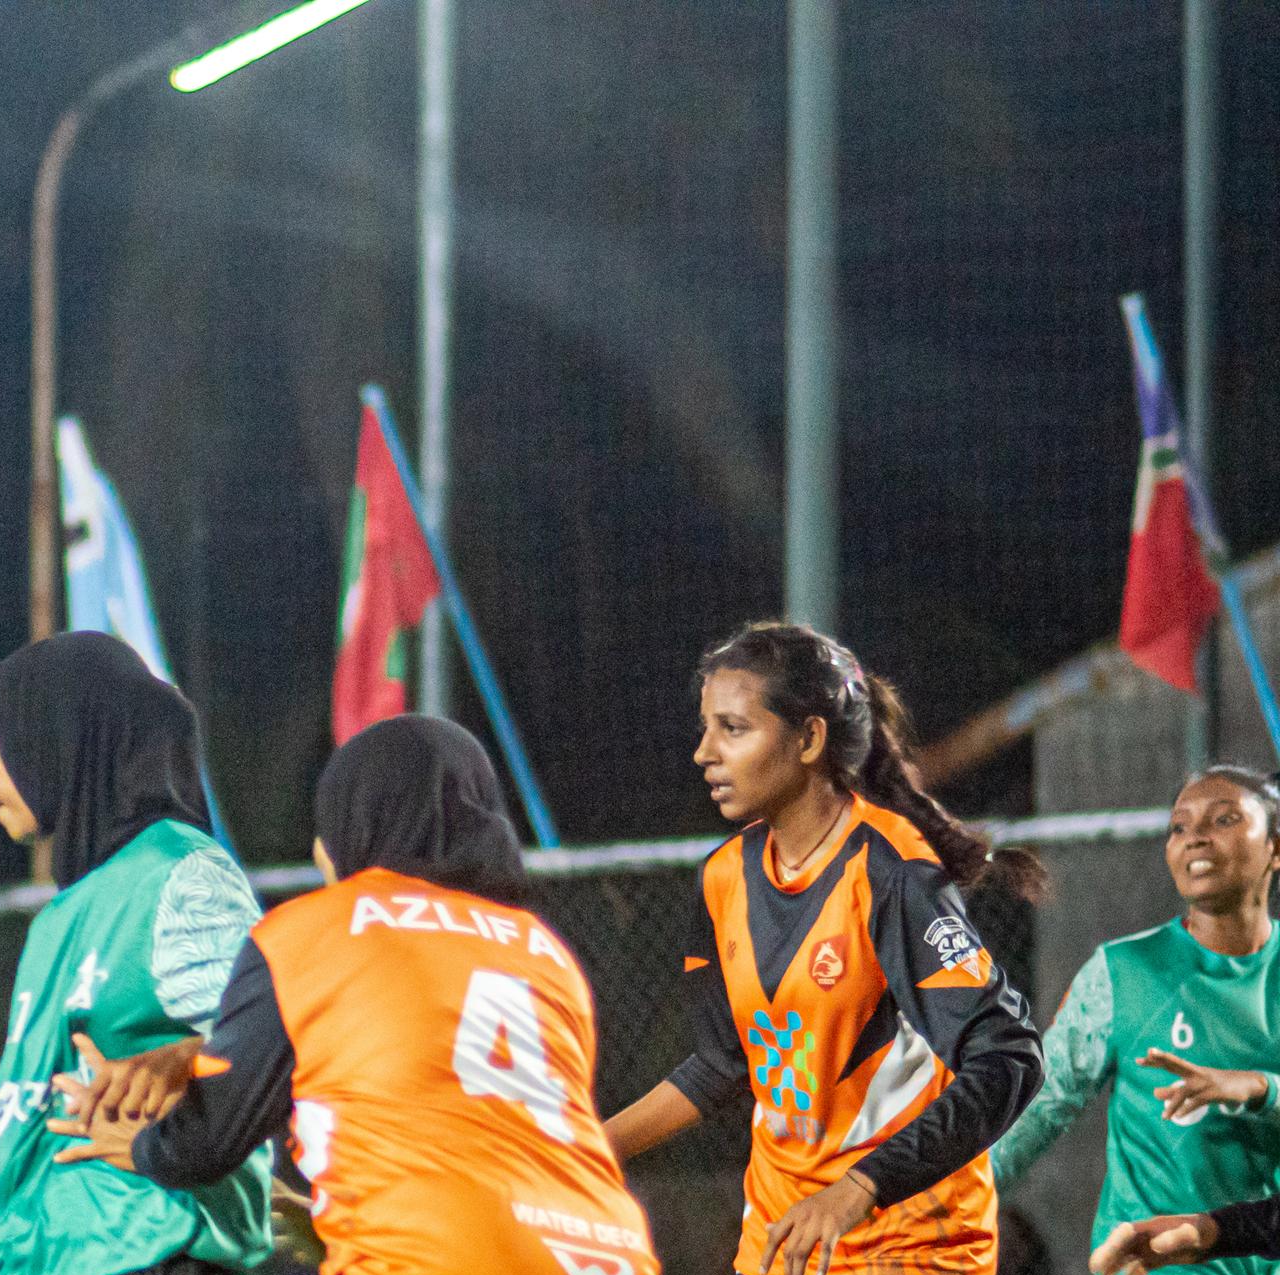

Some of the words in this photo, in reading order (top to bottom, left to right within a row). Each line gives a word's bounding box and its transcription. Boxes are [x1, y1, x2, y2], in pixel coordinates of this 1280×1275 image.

[349, 895, 567, 969] AZLIFA
[452, 968, 576, 1144] 4
[1171, 1010, 1194, 1050] 6
[511, 1202, 592, 1239] WATER
